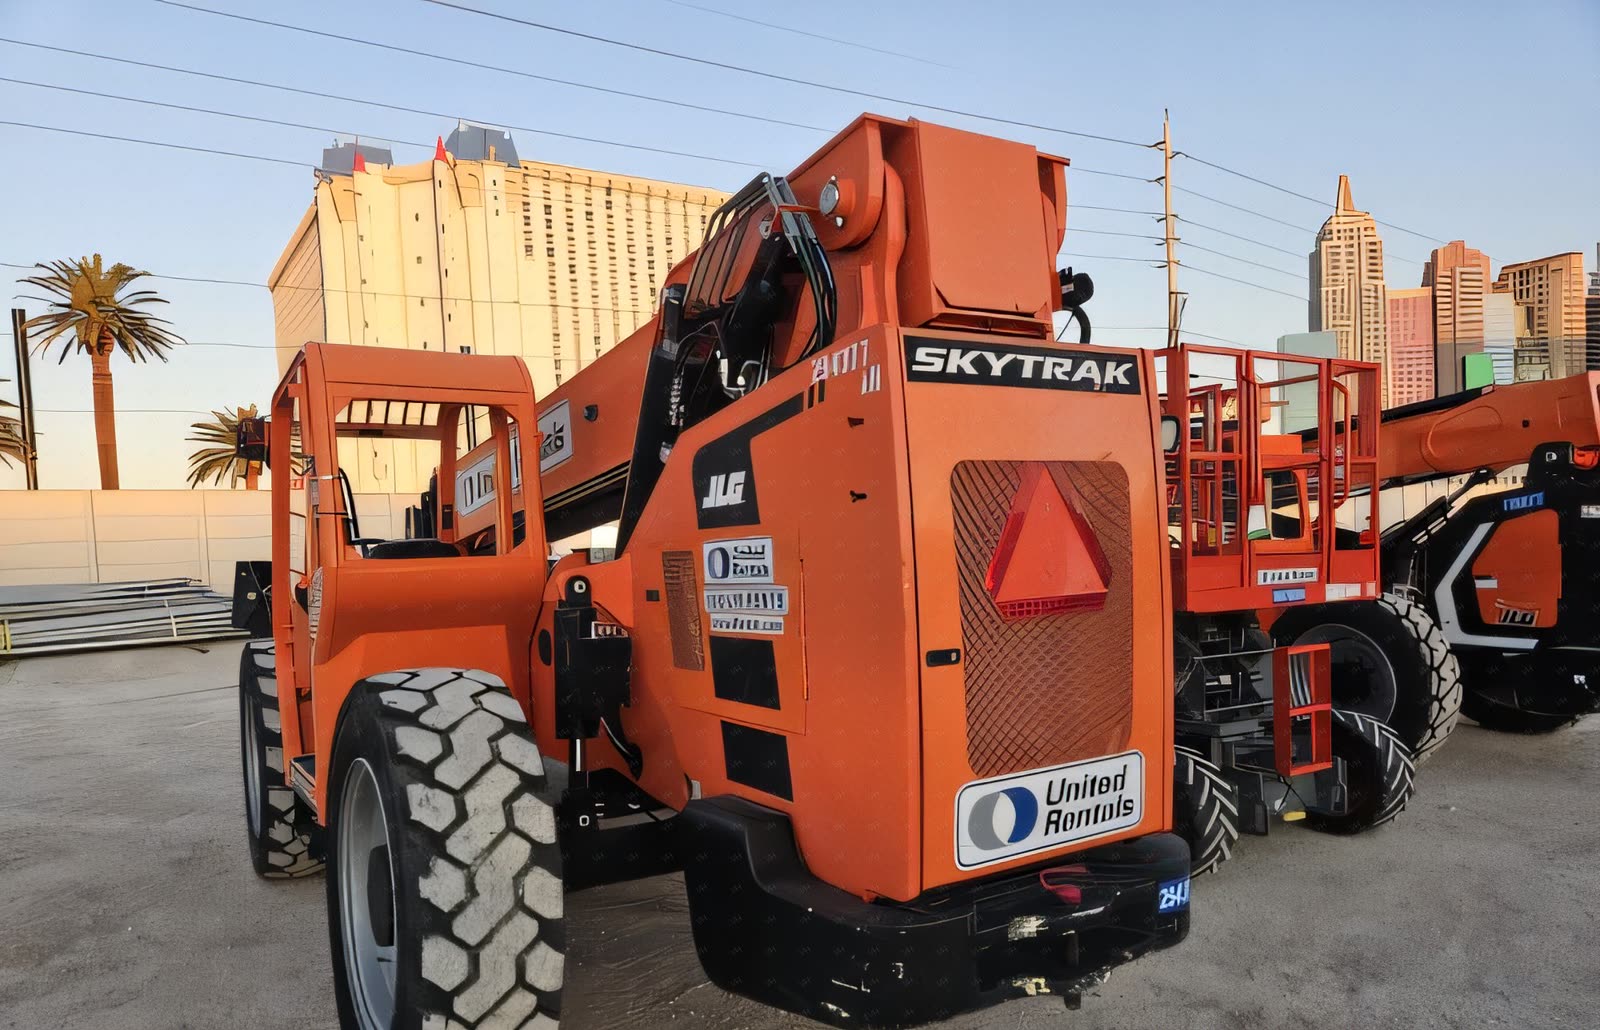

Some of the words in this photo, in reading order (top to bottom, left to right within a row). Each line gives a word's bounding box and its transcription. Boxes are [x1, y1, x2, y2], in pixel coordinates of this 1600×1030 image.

[911, 347, 1133, 387] SKYTRAK
[702, 471, 746, 509] JLG
[1046, 764, 1127, 806] United
